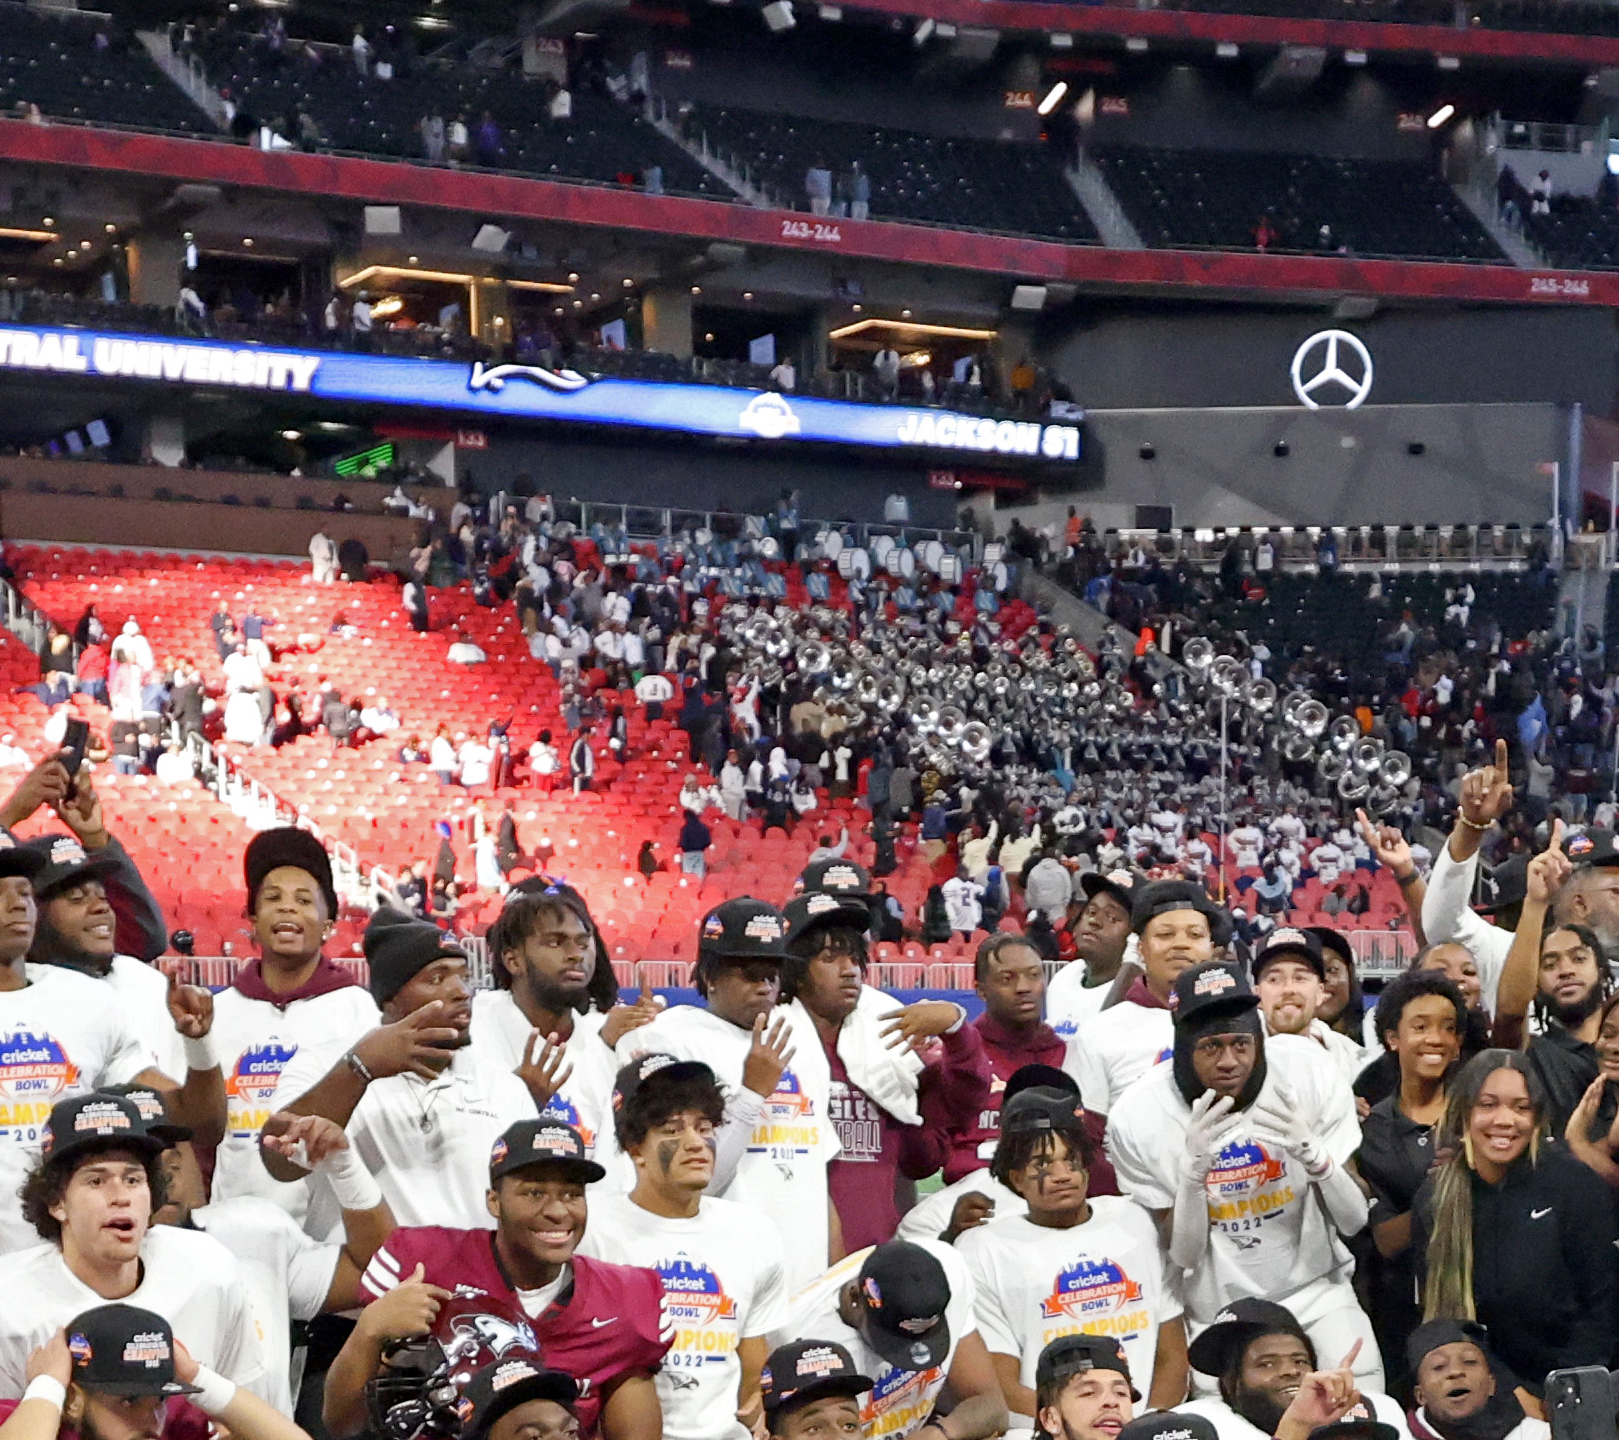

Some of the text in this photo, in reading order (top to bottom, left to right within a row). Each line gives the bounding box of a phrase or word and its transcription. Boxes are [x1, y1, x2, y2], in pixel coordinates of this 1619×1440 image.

[94, 333, 321, 392] UNIVERSITY
[897, 413, 1039, 454] JACKSON
[2, 1049, 50, 1064] cricket
[15, 1080, 50, 1092] BOWL
[1068, 1273, 1110, 1289] cricket
[1058, 1283, 1141, 1305] CELEBRATION
[1082, 1300, 1111, 1311] BOWL
[133, 1332, 164, 1345] cricket
